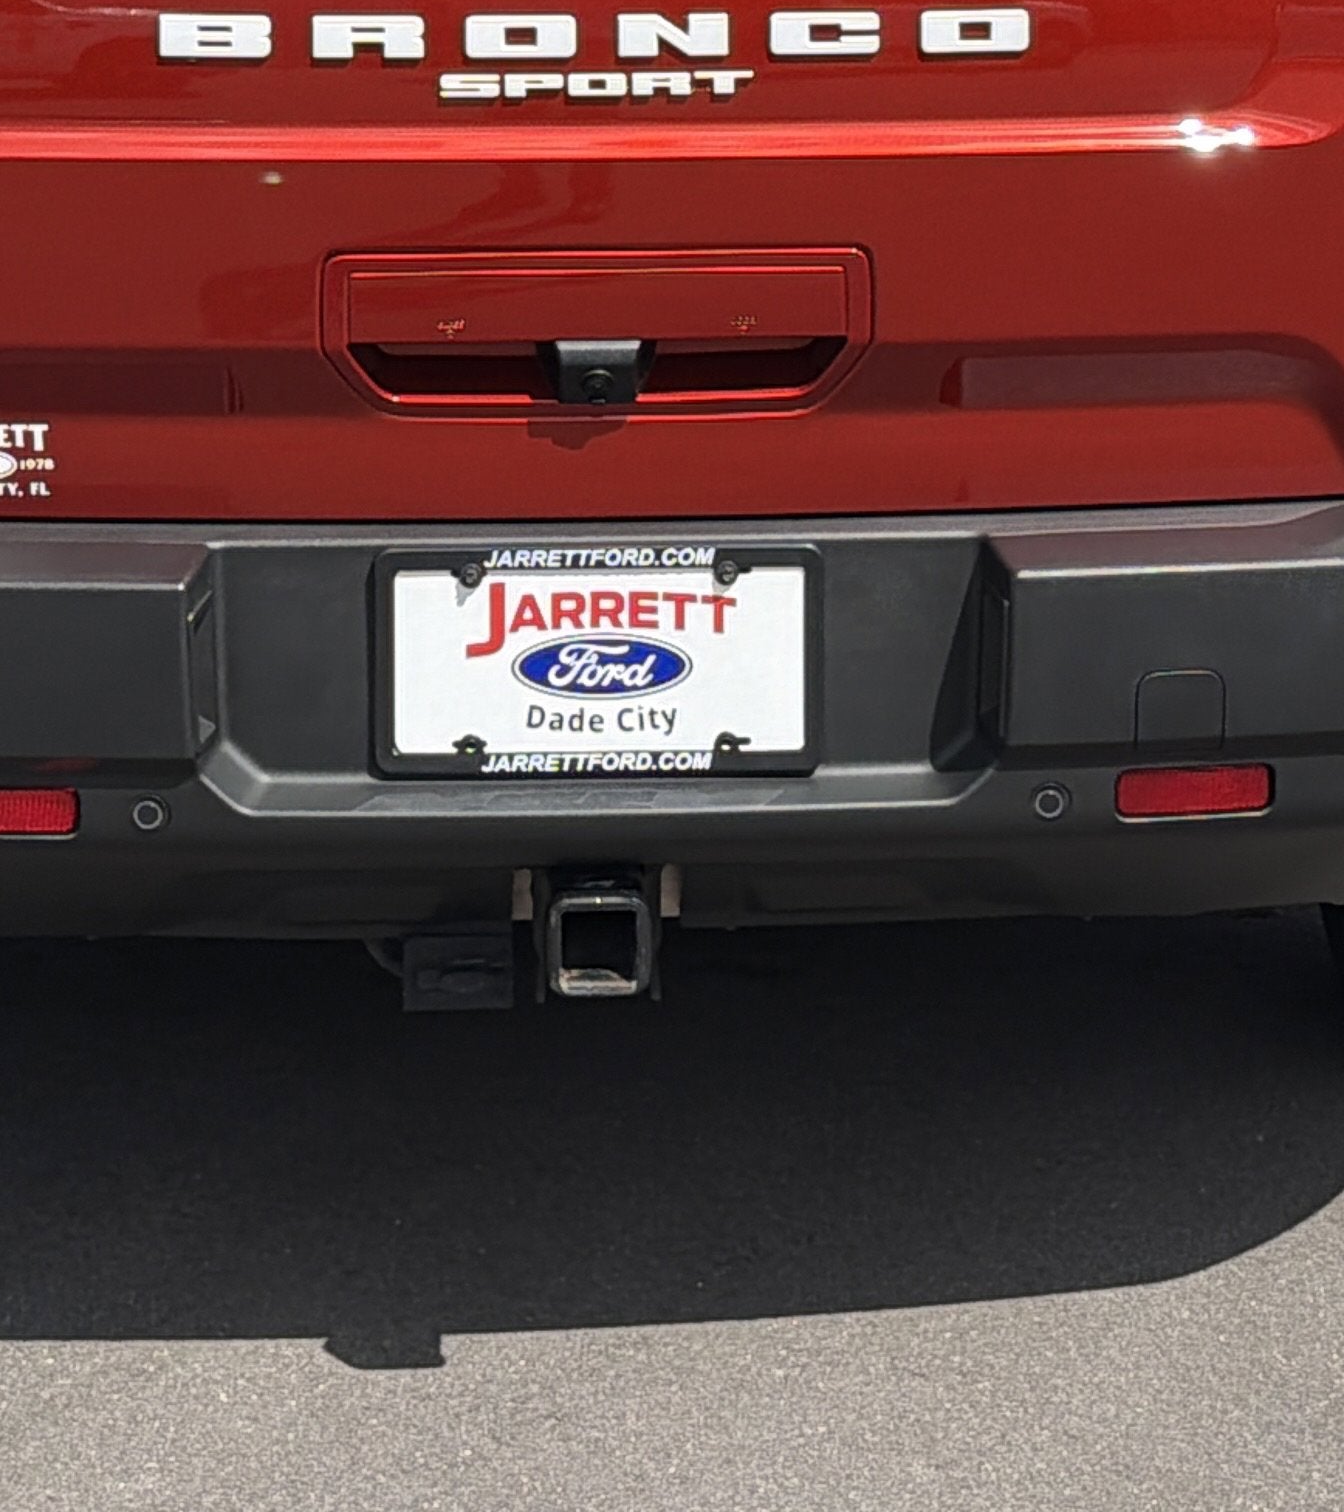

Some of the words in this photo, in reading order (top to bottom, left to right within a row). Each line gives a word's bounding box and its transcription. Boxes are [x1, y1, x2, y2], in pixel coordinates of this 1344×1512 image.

[157, 8, 1030, 59] BRONCO
[438, 68, 755, 98] SPORT
[19, 458, 55, 471] 1978
[29, 481, 51, 496] FL
[483, 547, 716, 569] JARRETTFORD.COM
[466, 582, 737, 659] JARRETT
[546, 641, 657, 689] Ford
[526, 704, 605, 733] Dade
[617, 705, 678, 736] City
[481, 751, 712, 773] JARRETTFORD.COM
